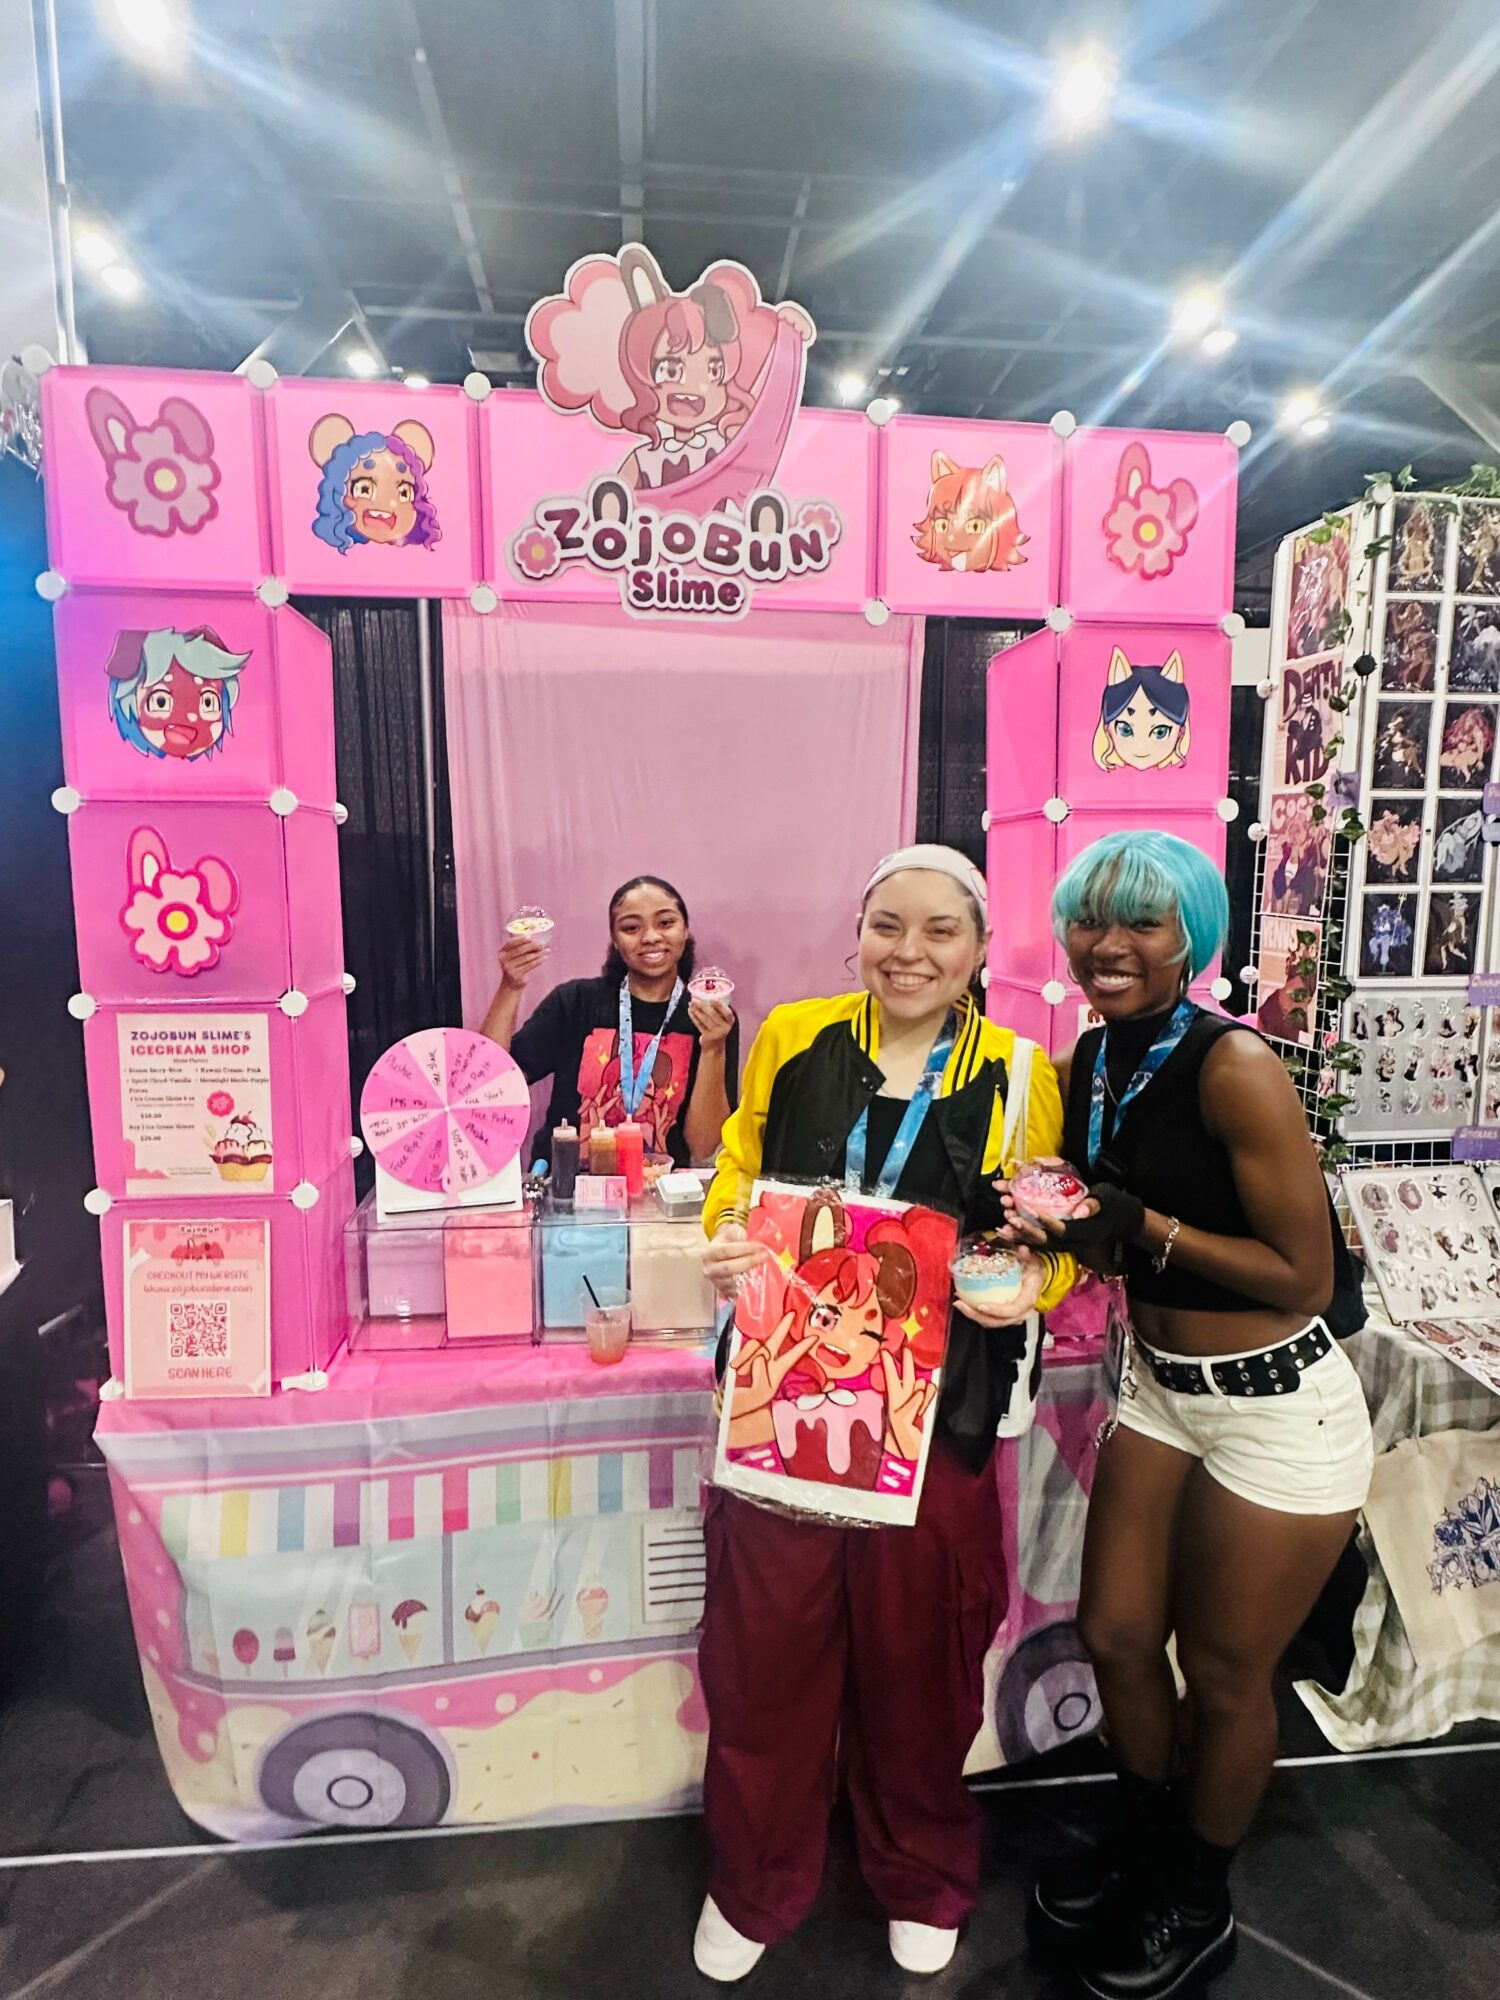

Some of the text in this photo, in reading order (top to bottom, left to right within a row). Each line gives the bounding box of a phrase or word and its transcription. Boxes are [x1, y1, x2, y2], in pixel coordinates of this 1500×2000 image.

[632, 567, 740, 606] Slime
[131, 1031, 252, 1040] ZOJOBUN SLIME'S
[131, 1045, 250, 1055] ICECREAM SHOP
[168, 1366, 232, 1380] SCAN HERE
